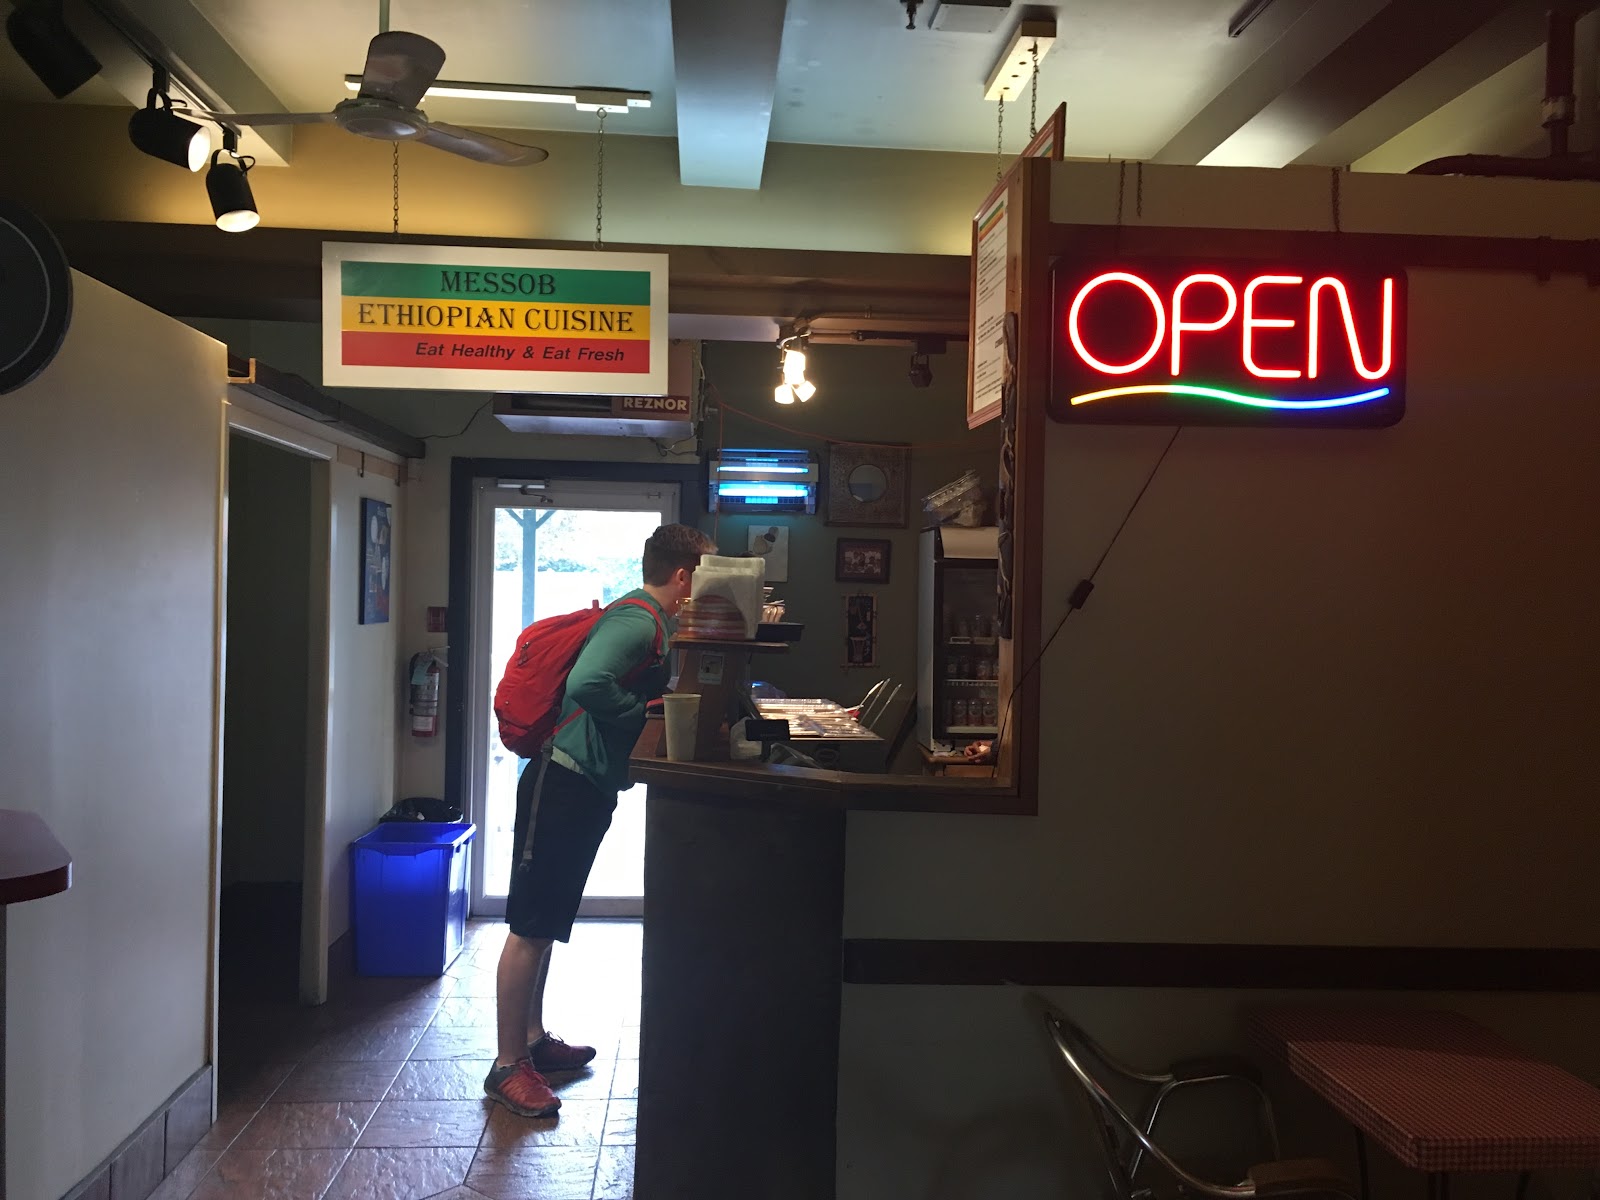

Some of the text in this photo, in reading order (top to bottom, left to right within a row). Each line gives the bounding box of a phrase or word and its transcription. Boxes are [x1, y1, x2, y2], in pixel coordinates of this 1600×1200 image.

[440, 270, 556, 295] MESSOB
[358, 303, 634, 332] ETHIOPIAN CUISINE
[1068, 271, 1393, 380] OPEN
[415, 342, 625, 361] Eat Healthy & Eat Fresh
[623, 396, 688, 411] REZNOR
